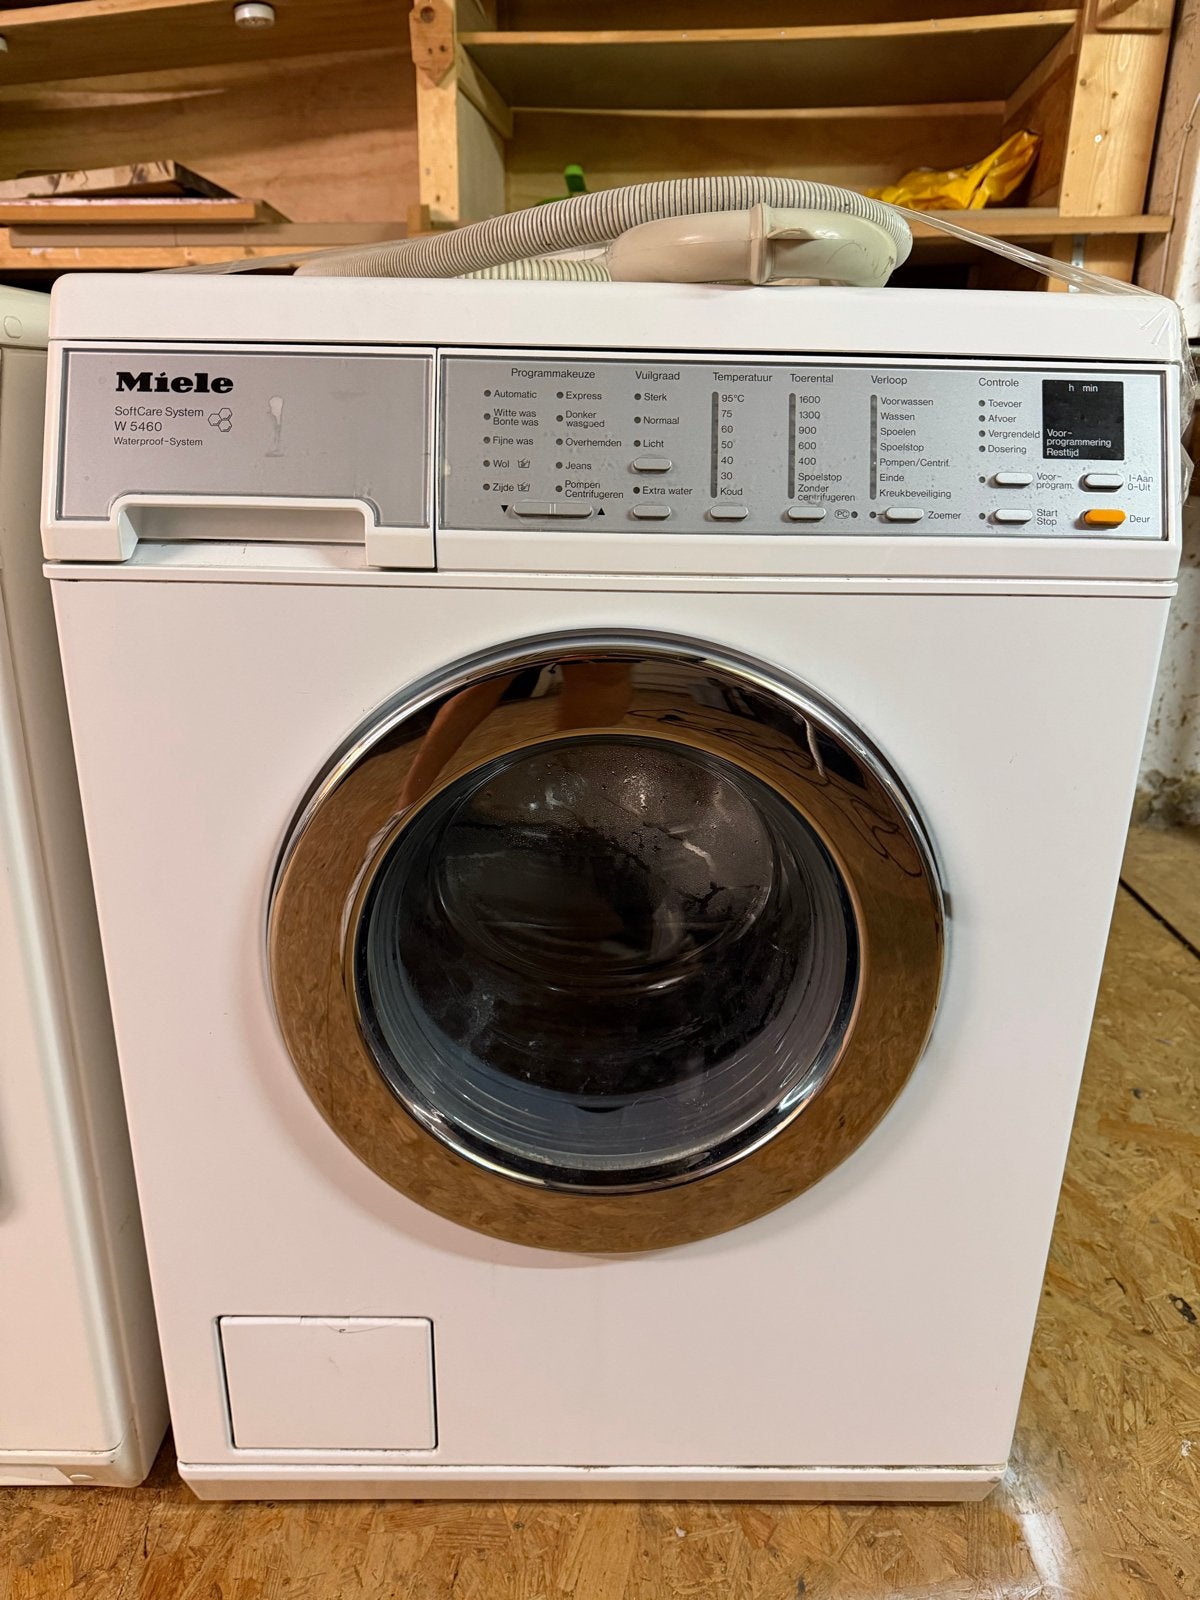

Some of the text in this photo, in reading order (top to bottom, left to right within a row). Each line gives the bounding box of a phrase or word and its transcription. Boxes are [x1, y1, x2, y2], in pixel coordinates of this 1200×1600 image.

[511, 368, 595, 379] Programmakeuze
[635, 371, 680, 381] Vuilgraad
[712, 372, 773, 382] Temperatuur
[790, 373, 834, 383] Toerental
[116, 372, 234, 394] Miele
[871, 375, 907, 386] Verloop
[979, 378, 1019, 387] Controle
[1083, 384, 1098, 392] min
[494, 390, 537, 398] Automatic
[566, 391, 602, 400] Express
[644, 393, 667, 401] Sterk
[799, 396, 821, 404] 1600
[880, 397, 933, 406] Voorwassen
[988, 400, 1022, 408] Toevoer
[114, 406, 204, 418] SoftCare System
[494, 408, 536, 418] Witte was
[566, 410, 597, 418] Donker
[722, 410, 732, 418] 75
[799, 411, 821, 419] 1300
[880, 412, 915, 420] Wassen
[493, 417, 518, 426] Bonte
[643, 416, 679, 424] Normaal
[988, 415, 1016, 423] Afvoer
[114, 421, 162, 432] W 5460
[566, 420, 605, 429] wasgoed
[880, 428, 916, 437] Spoelen
[988, 430, 1040, 439] Vergrendeld
[114, 437, 203, 447] Waterproof-System
[492, 436, 514, 446] Fijne
[566, 438, 622, 447] Overhemden
[643, 440, 664, 448] Licht
[1047, 438, 1112, 448] programmering
[798, 442, 817, 450] 600
[880, 443, 924, 452] Spoelstop
[988, 445, 1027, 454] Dosering
[1047, 448, 1079, 457] Resttijd
[493, 460, 510, 468] Wol
[721, 456, 734, 464] 40
[798, 458, 817, 466] 400
[565, 462, 592, 470] Jeans
[720, 472, 732, 480] 30
[798, 473, 842, 482] Spoelstop
[879, 474, 904, 482] Einde
[492, 483, 514, 492] Zijde
[565, 480, 600, 490] Pompen
[798, 484, 829, 492] Zonder
[1036, 481, 1073, 491] program.
[565, 490, 624, 500] Centrifugeren
[642, 486, 665, 495] Extra
[879, 489, 951, 499] Kreukbeveiliging
[798, 493, 855, 502] centrifugeren
[837, 510, 848, 518] PC
[928, 511, 961, 520] Zoemer
[1037, 509, 1058, 517] Start
[1037, 518, 1057, 526] Stop
[1129, 515, 1150, 523] Deur
